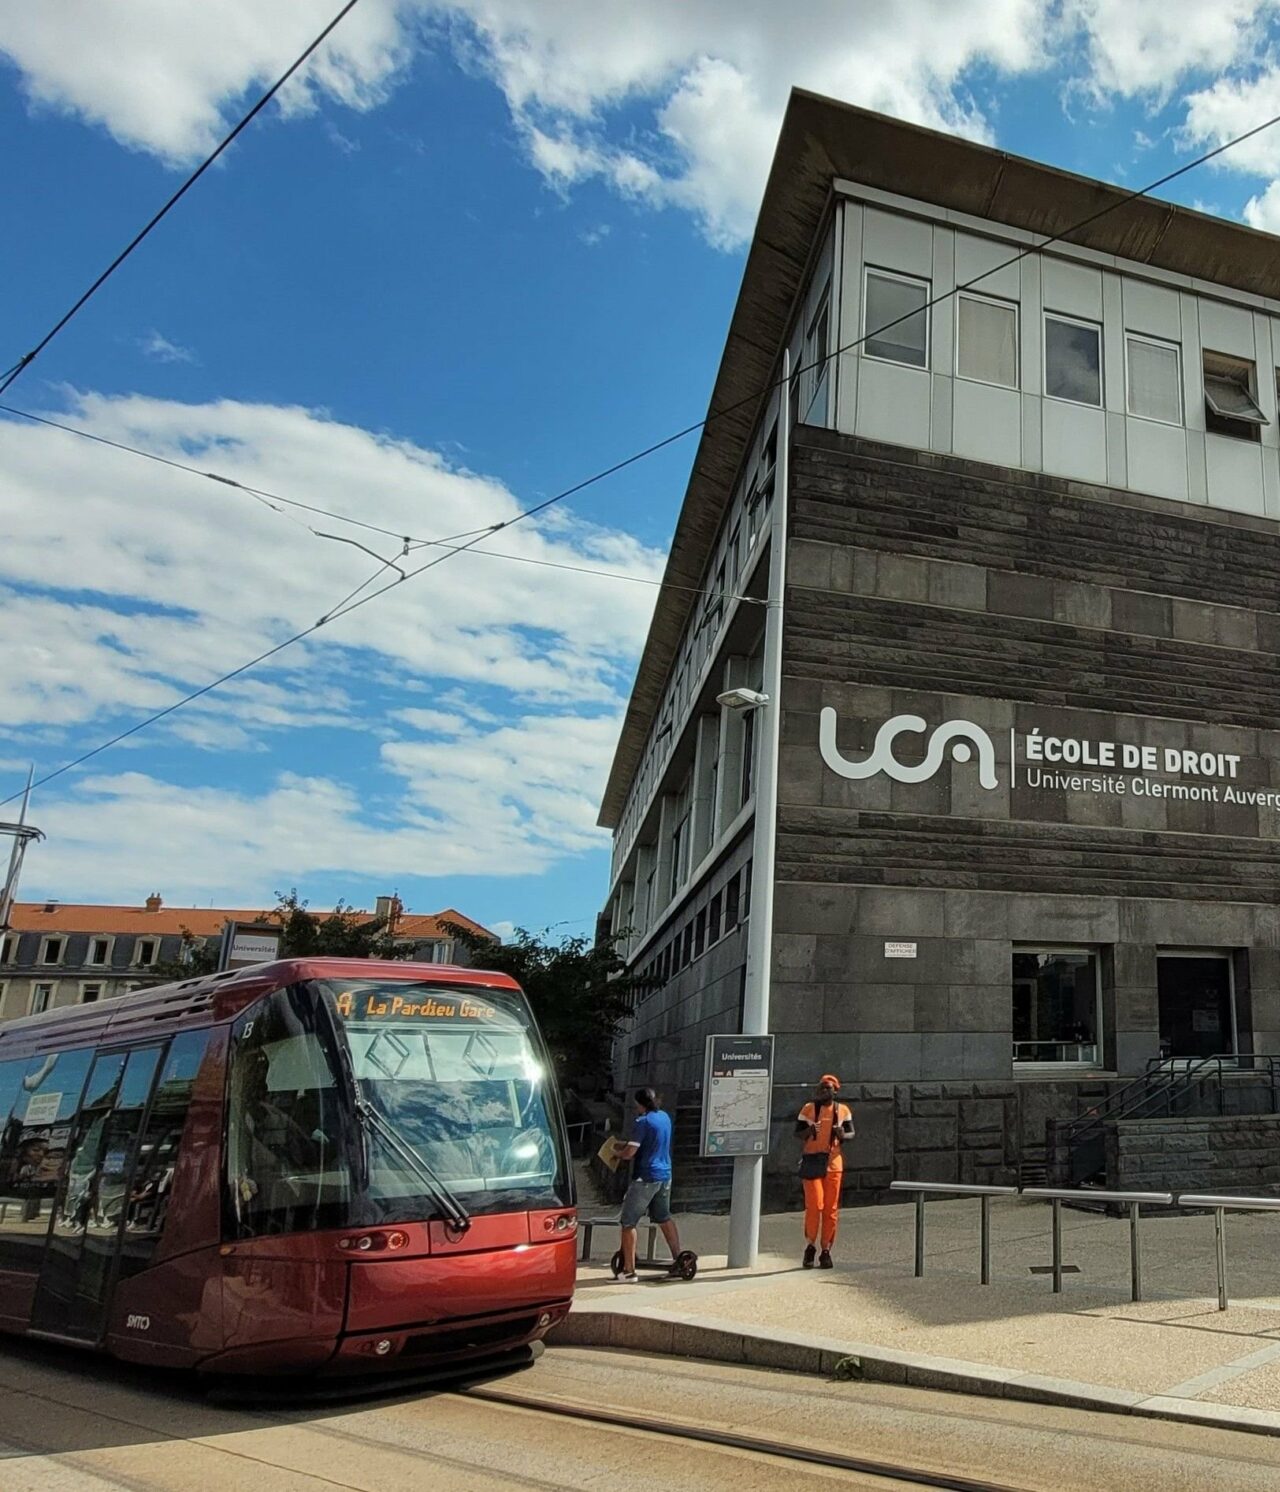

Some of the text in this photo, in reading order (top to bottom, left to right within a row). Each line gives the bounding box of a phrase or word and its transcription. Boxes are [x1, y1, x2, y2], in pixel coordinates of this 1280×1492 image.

[1026, 727, 1241, 778] ÉCOLE DE DROIT
[1027, 767, 1126, 794] Université
[1131, 777, 1219, 803] Clermont
[232, 944, 276, 953] Universités
[335, 992, 496, 1018] A La Pardieu Gare
[721, 1052, 763, 1061] Universités
